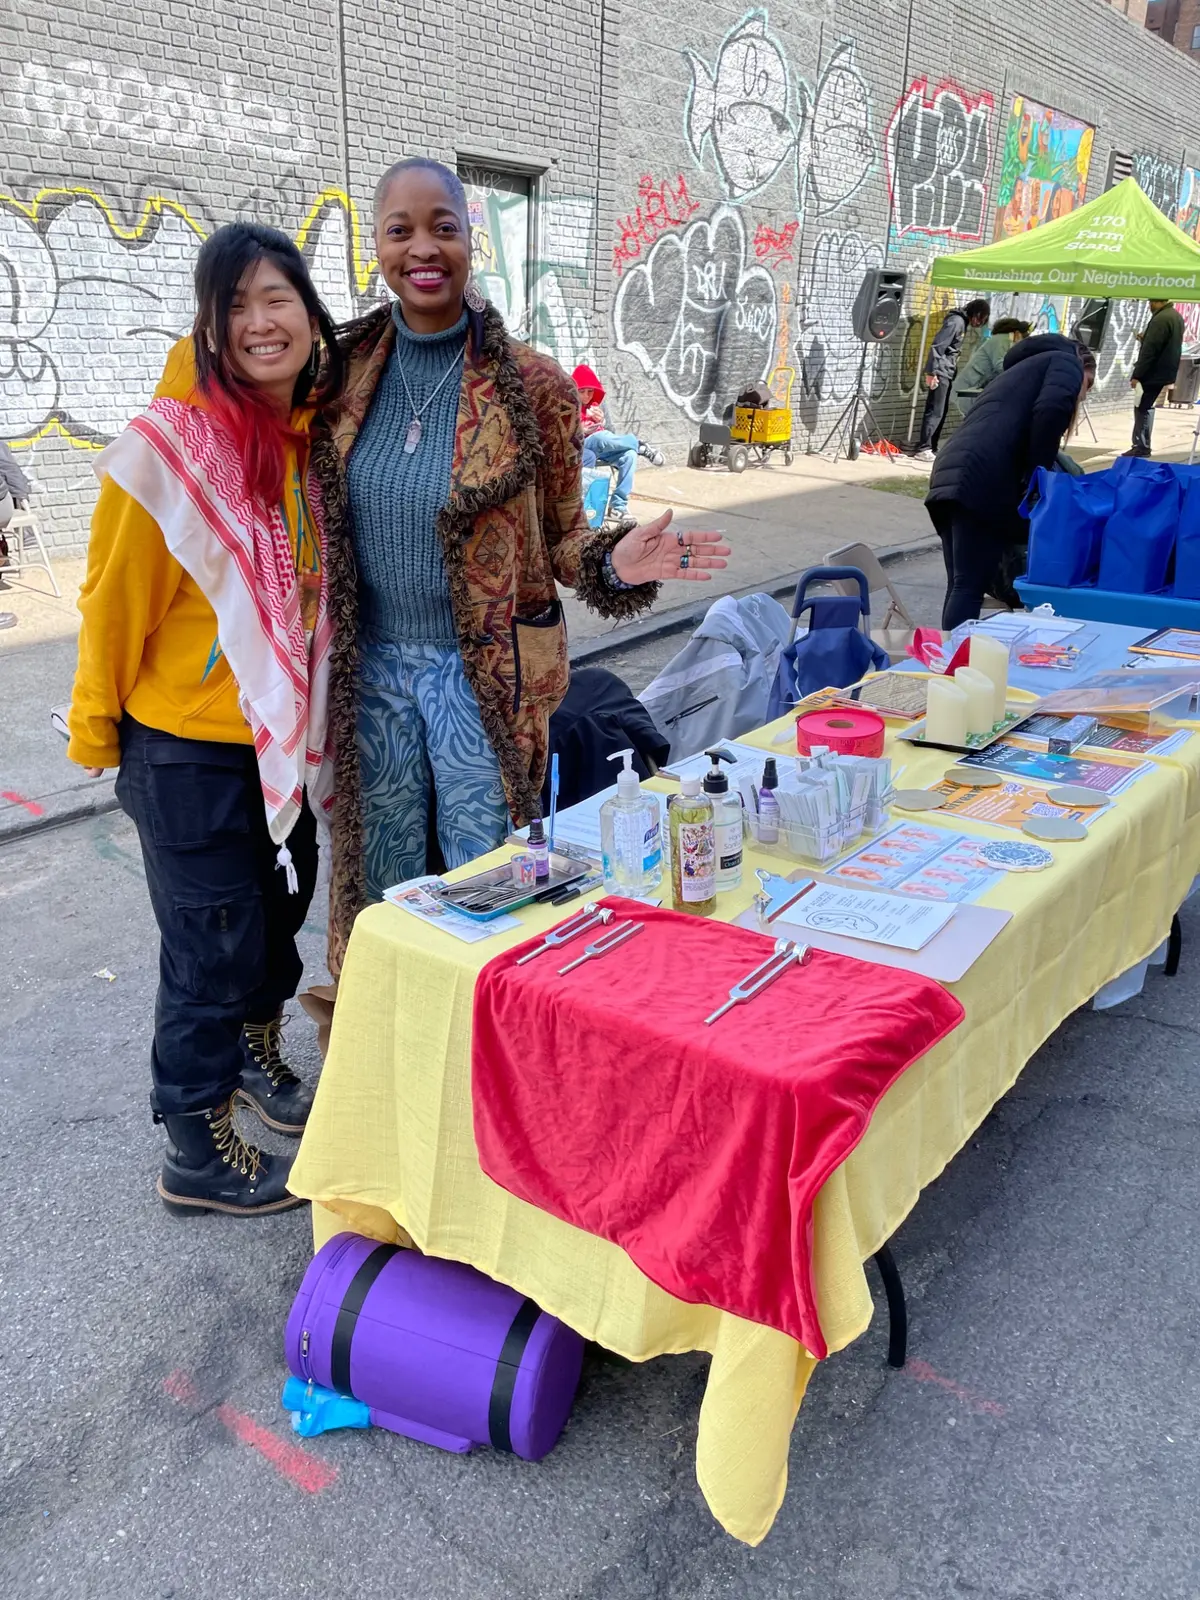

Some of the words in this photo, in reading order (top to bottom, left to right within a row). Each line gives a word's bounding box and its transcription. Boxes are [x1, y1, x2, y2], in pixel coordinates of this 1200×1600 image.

[1090, 215, 1126, 227] 170
[1075, 229, 1124, 241] Farm
[1063, 241, 1122, 252] Stand
[963, 268, 1043, 285] Nourishing
[1048, 268, 1078, 282] Our
[1081, 268, 1197, 288] Neighborhood
